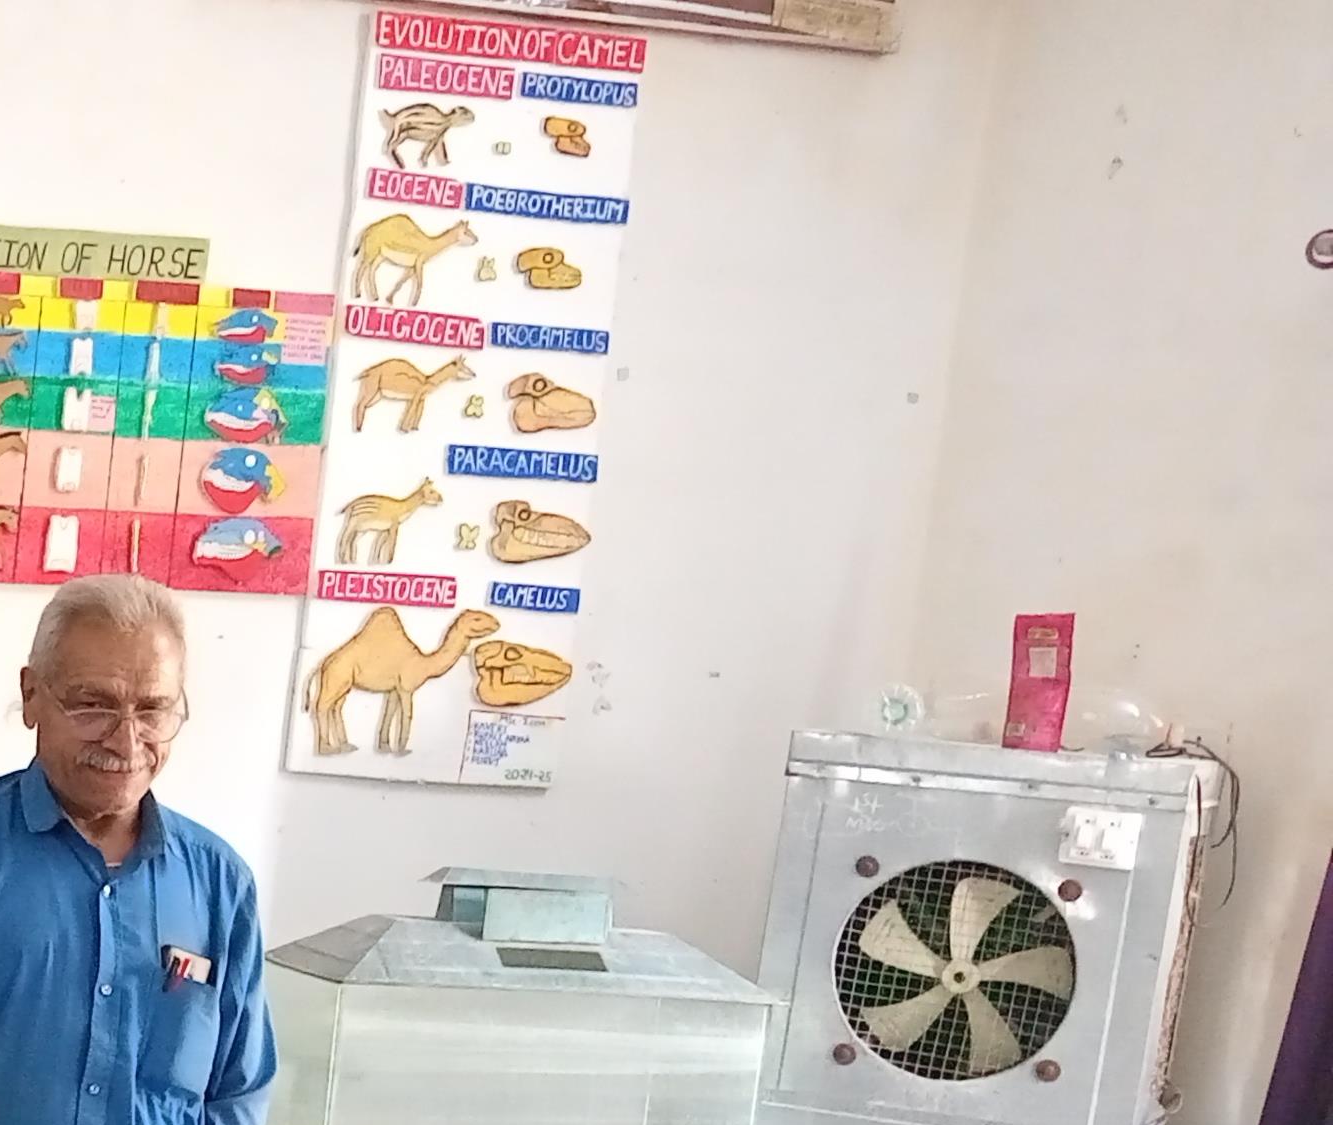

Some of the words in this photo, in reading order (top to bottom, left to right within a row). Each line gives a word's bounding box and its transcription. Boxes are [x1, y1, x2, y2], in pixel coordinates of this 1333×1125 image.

[378, 15, 520, 59] EVOLUTION
[524, 31, 556, 61] OF
[556, 34, 644, 70] CAMEL
[379, 57, 511, 98] PALEOCENE
[524, 75, 635, 107] PROTYLOPUS
[371, 173, 457, 207] EOCENE
[471, 184, 624, 222] POEBROTHERIUM
[60, 241, 95, 275] OF
[107, 244, 205, 280] HORSE
[347, 307, 483, 348] OLIGOCENE
[496, 324, 607, 353] PROCAMELUS
[453, 446, 597, 482] PARACAMELUS
[321, 573, 456, 606] PLEISTOCENE
[493, 584, 569, 610] CAMELUS
